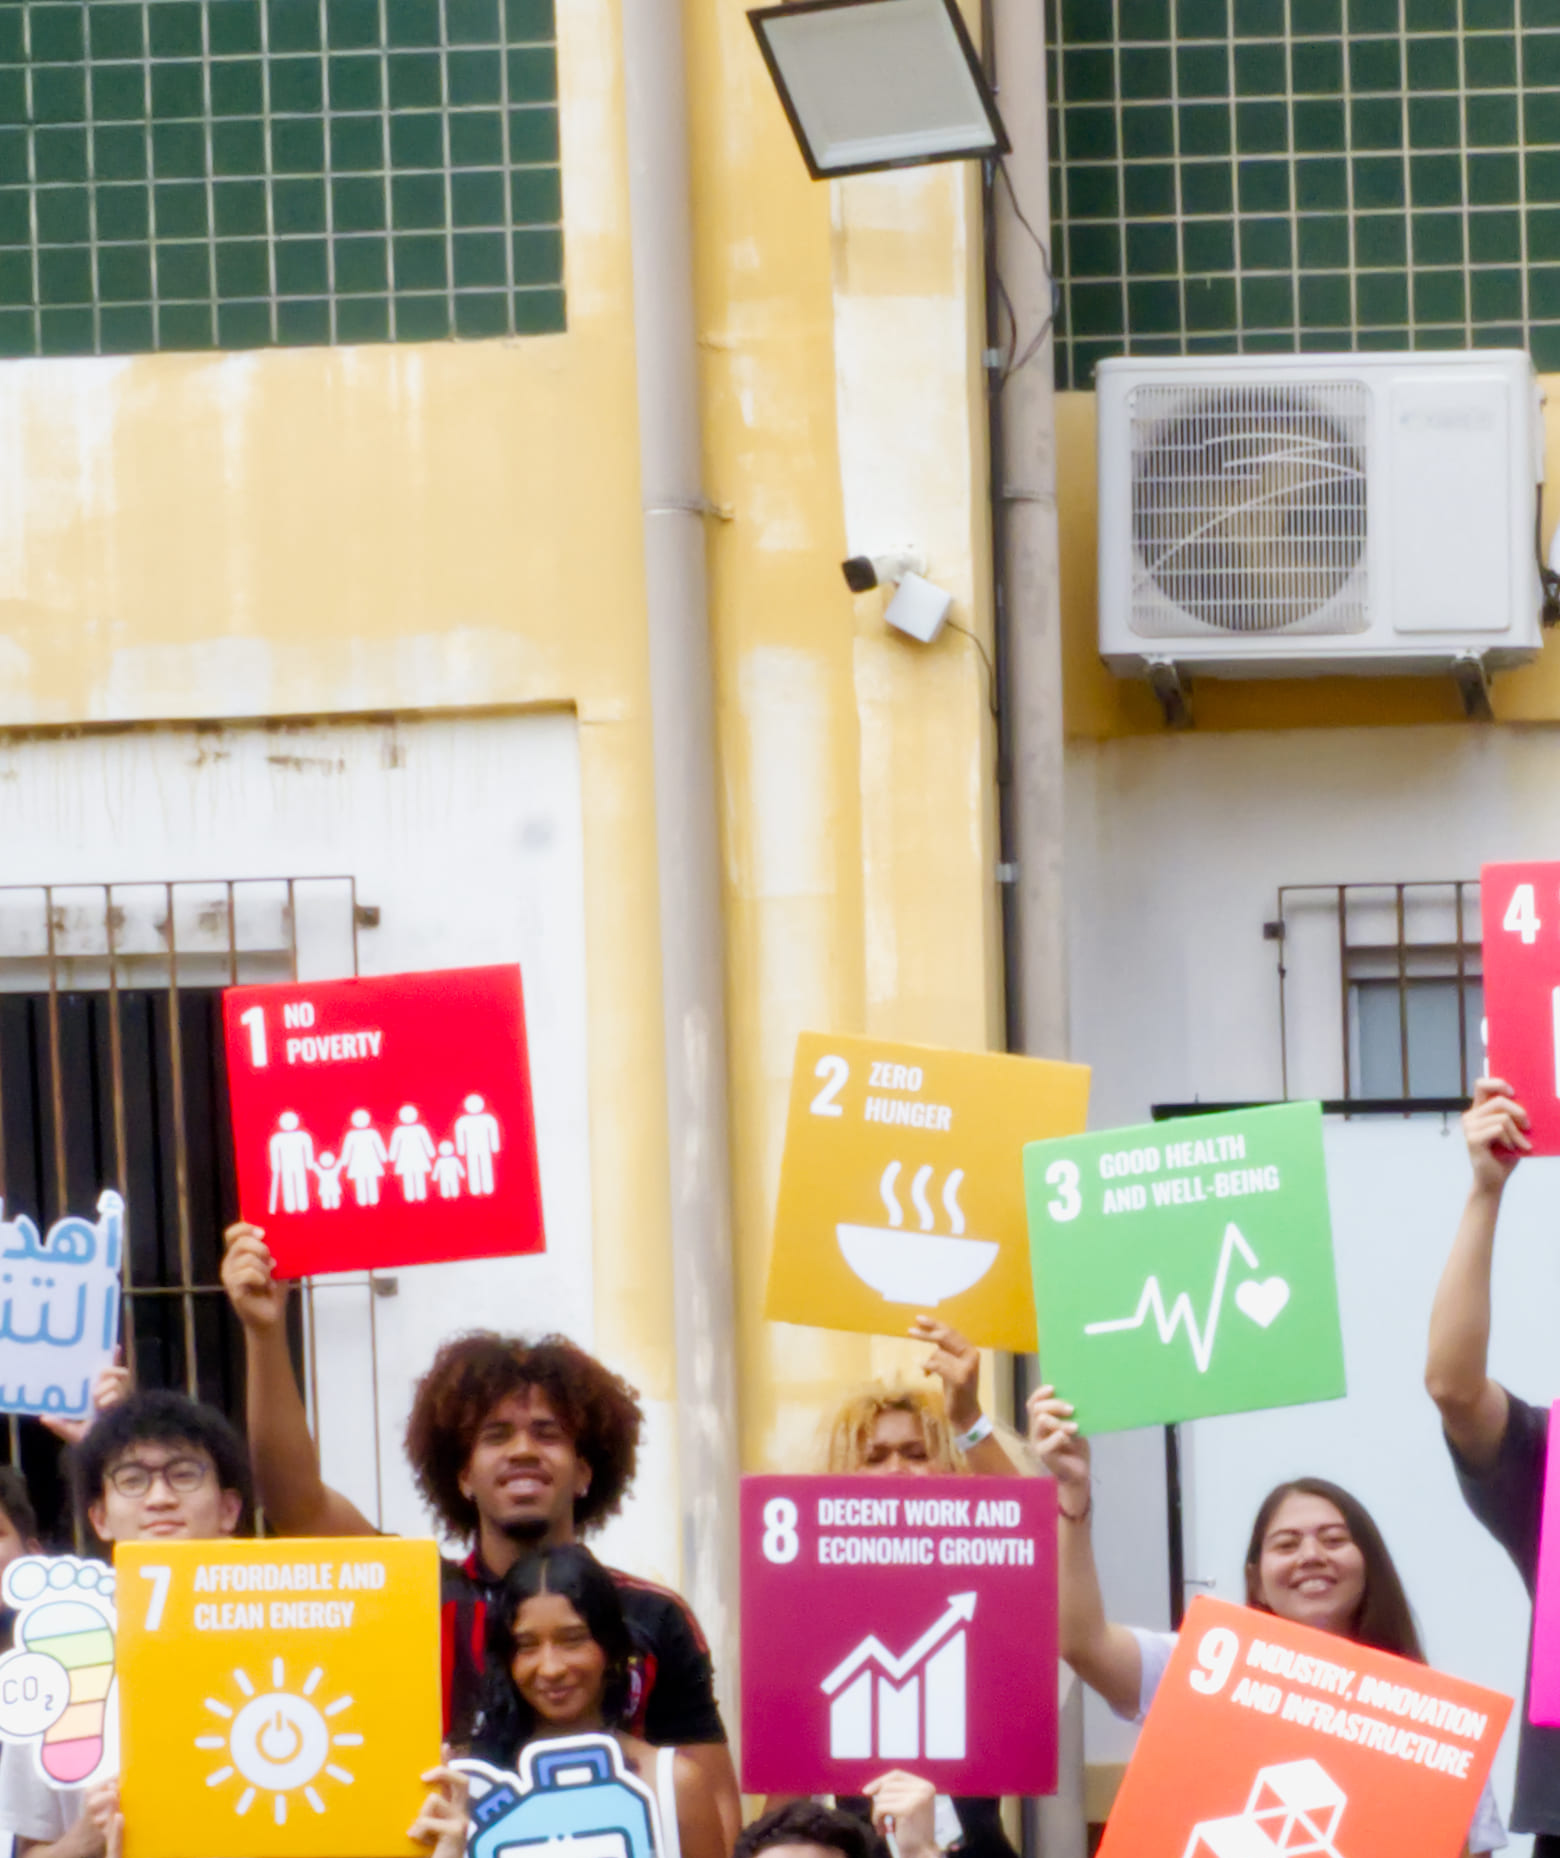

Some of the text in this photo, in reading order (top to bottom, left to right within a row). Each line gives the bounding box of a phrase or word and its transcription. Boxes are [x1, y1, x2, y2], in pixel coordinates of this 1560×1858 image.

[1503, 884, 1541, 944] 4
[241, 1006, 268, 1067] 1
[284, 1002, 314, 1028] NO
[287, 1031, 382, 1064] POVERTY
[810, 1055, 850, 1117] 2
[868, 1062, 923, 1092] ZERO
[864, 1096, 952, 1132] HUNGER
[1099, 1133, 1246, 1180] GOOD HEALTH
[1045, 1159, 1082, 1222] 3
[1102, 1166, 1280, 1215] AND WELL-BEING
[763, 1497, 799, 1564] 8
[818, 1499, 1021, 1527] DECENT WORK AND
[818, 1536, 1035, 1565] ECONOMIC GROWTH
[140, 1566, 171, 1631] 7
[194, 1562, 385, 1592] AFFORDABLE AND
[194, 1601, 354, 1630] CLEAN ENERGY
[1189, 1628, 1239, 1694] 9
[1246, 1639, 1489, 1741] INDUSTRY, INNOVATION
[1231, 1677, 1475, 1779] AND INFRASTRUCTURE
